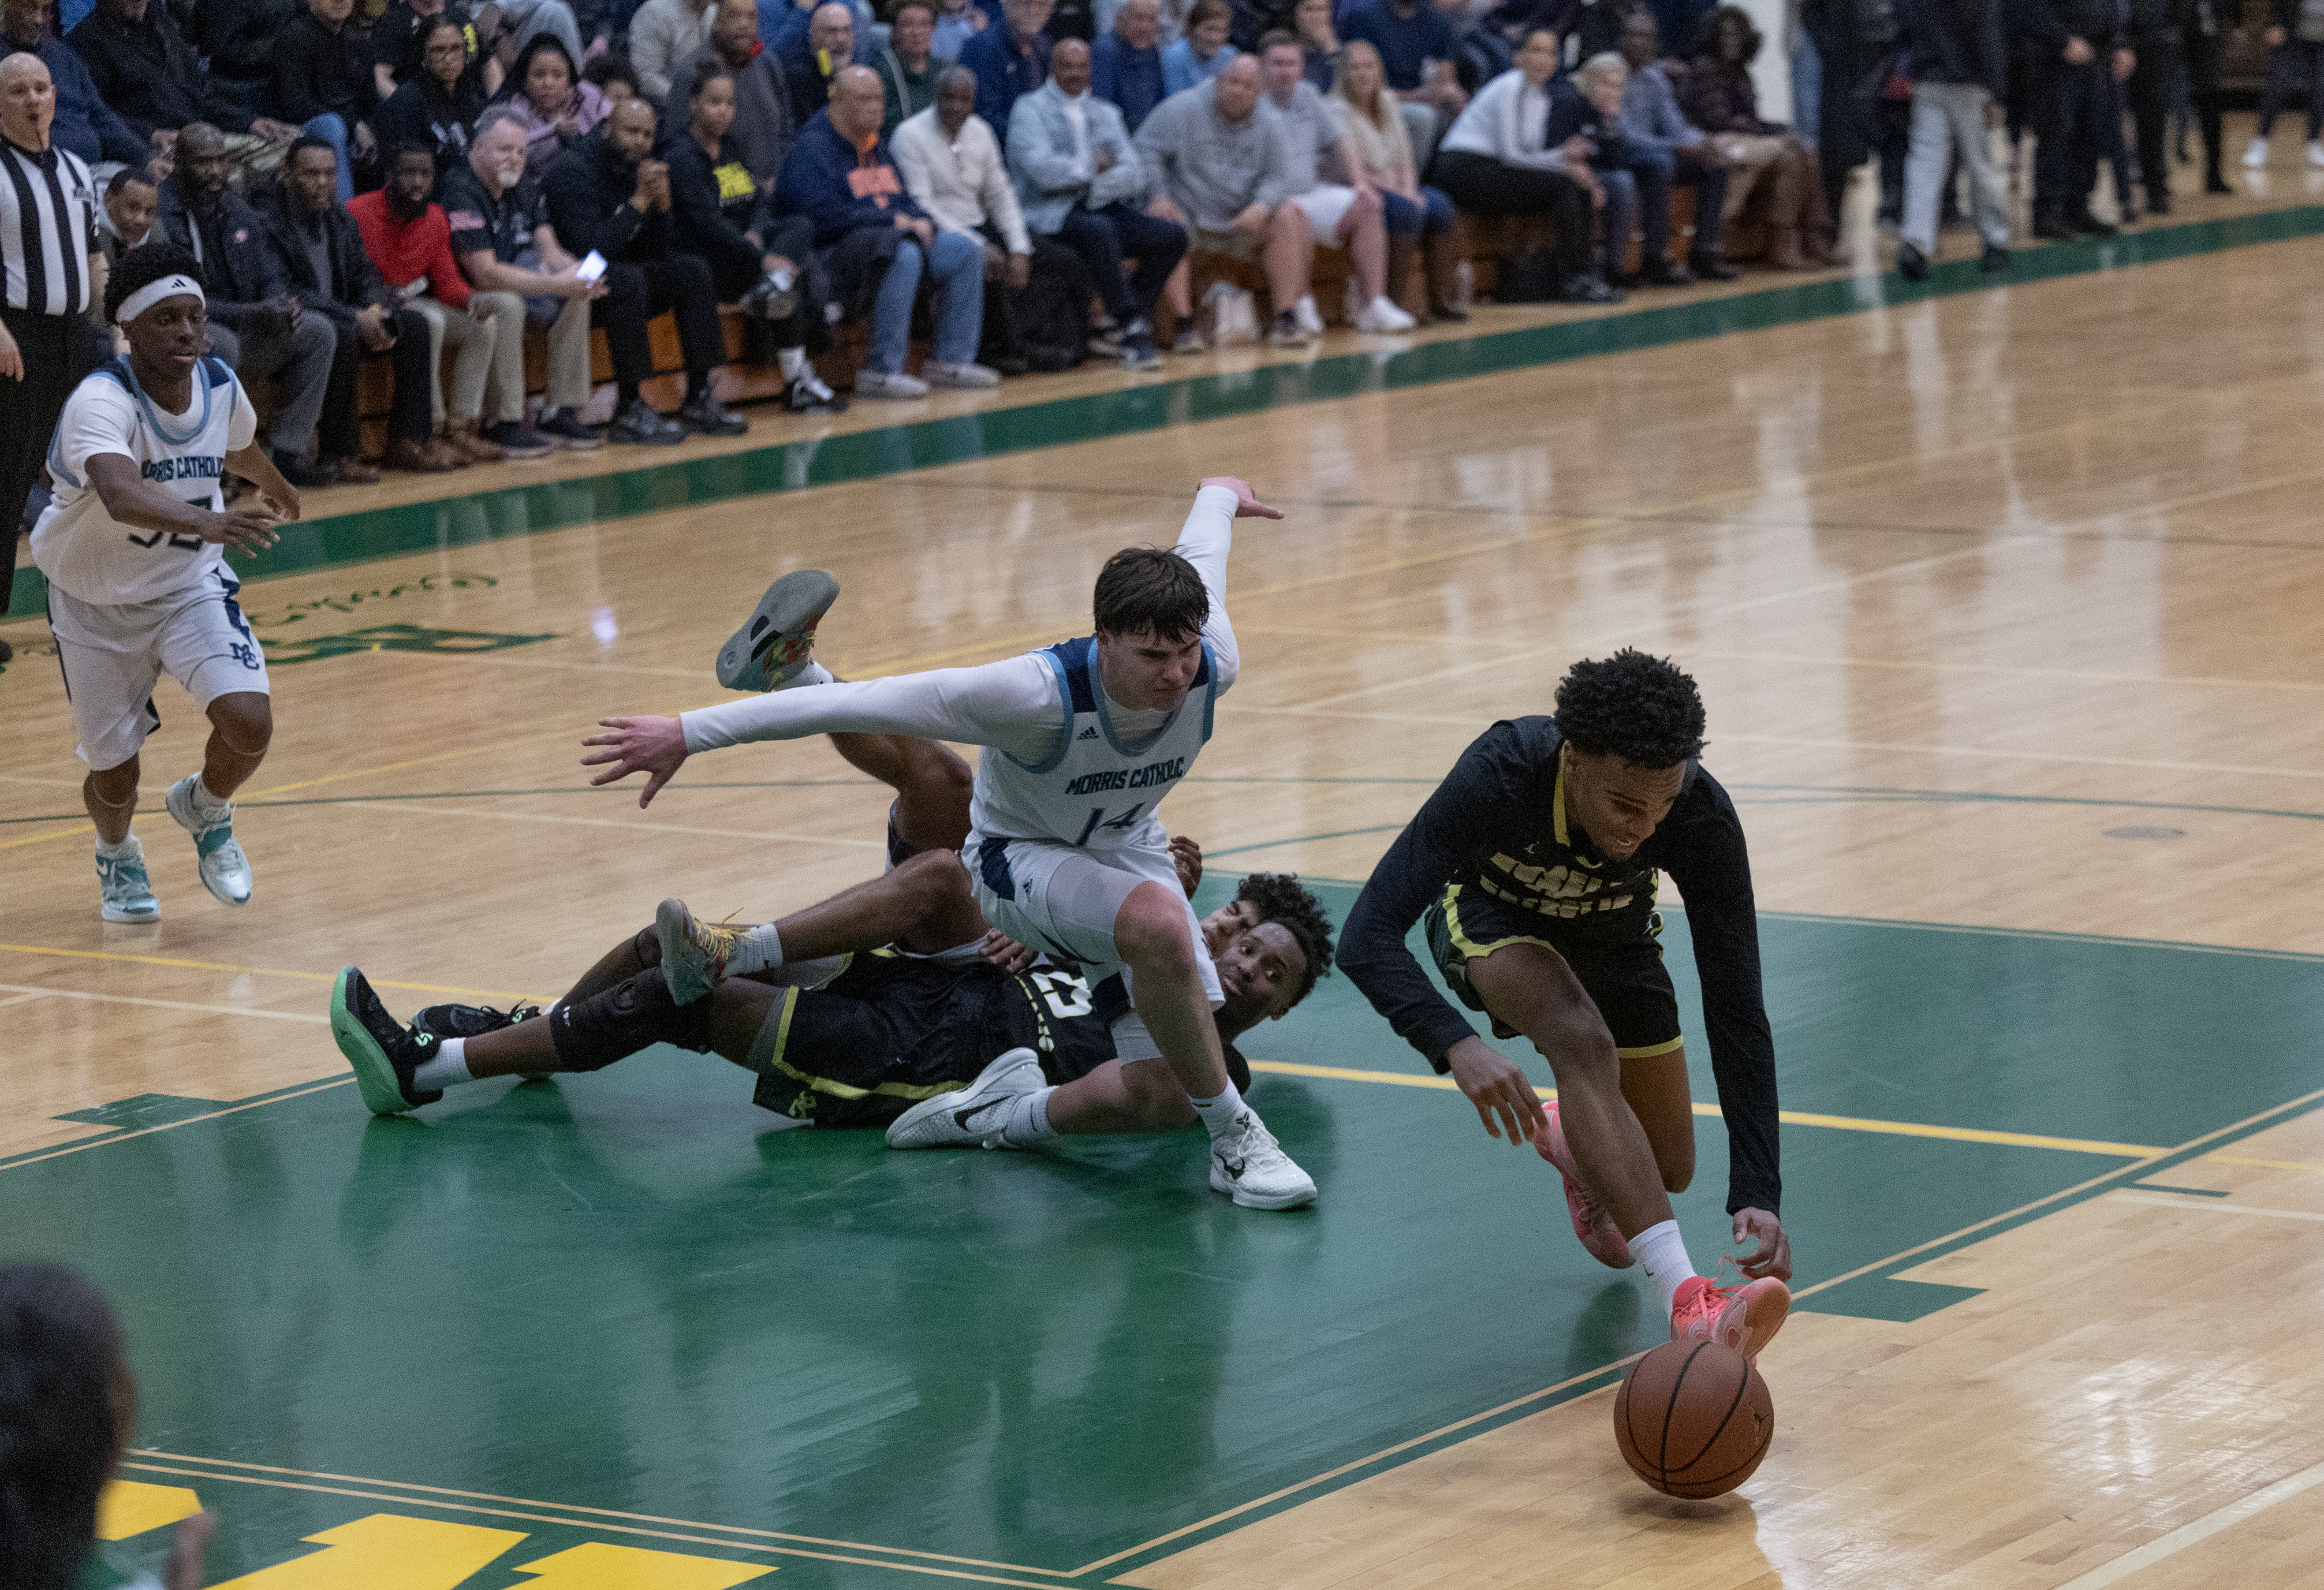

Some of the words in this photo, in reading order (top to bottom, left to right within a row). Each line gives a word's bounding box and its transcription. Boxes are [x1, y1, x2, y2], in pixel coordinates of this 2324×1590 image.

[142, 459, 174, 482] ORRIS
[1065, 770, 1128, 795] MORRIS
[1076, 801, 1147, 847] 14
